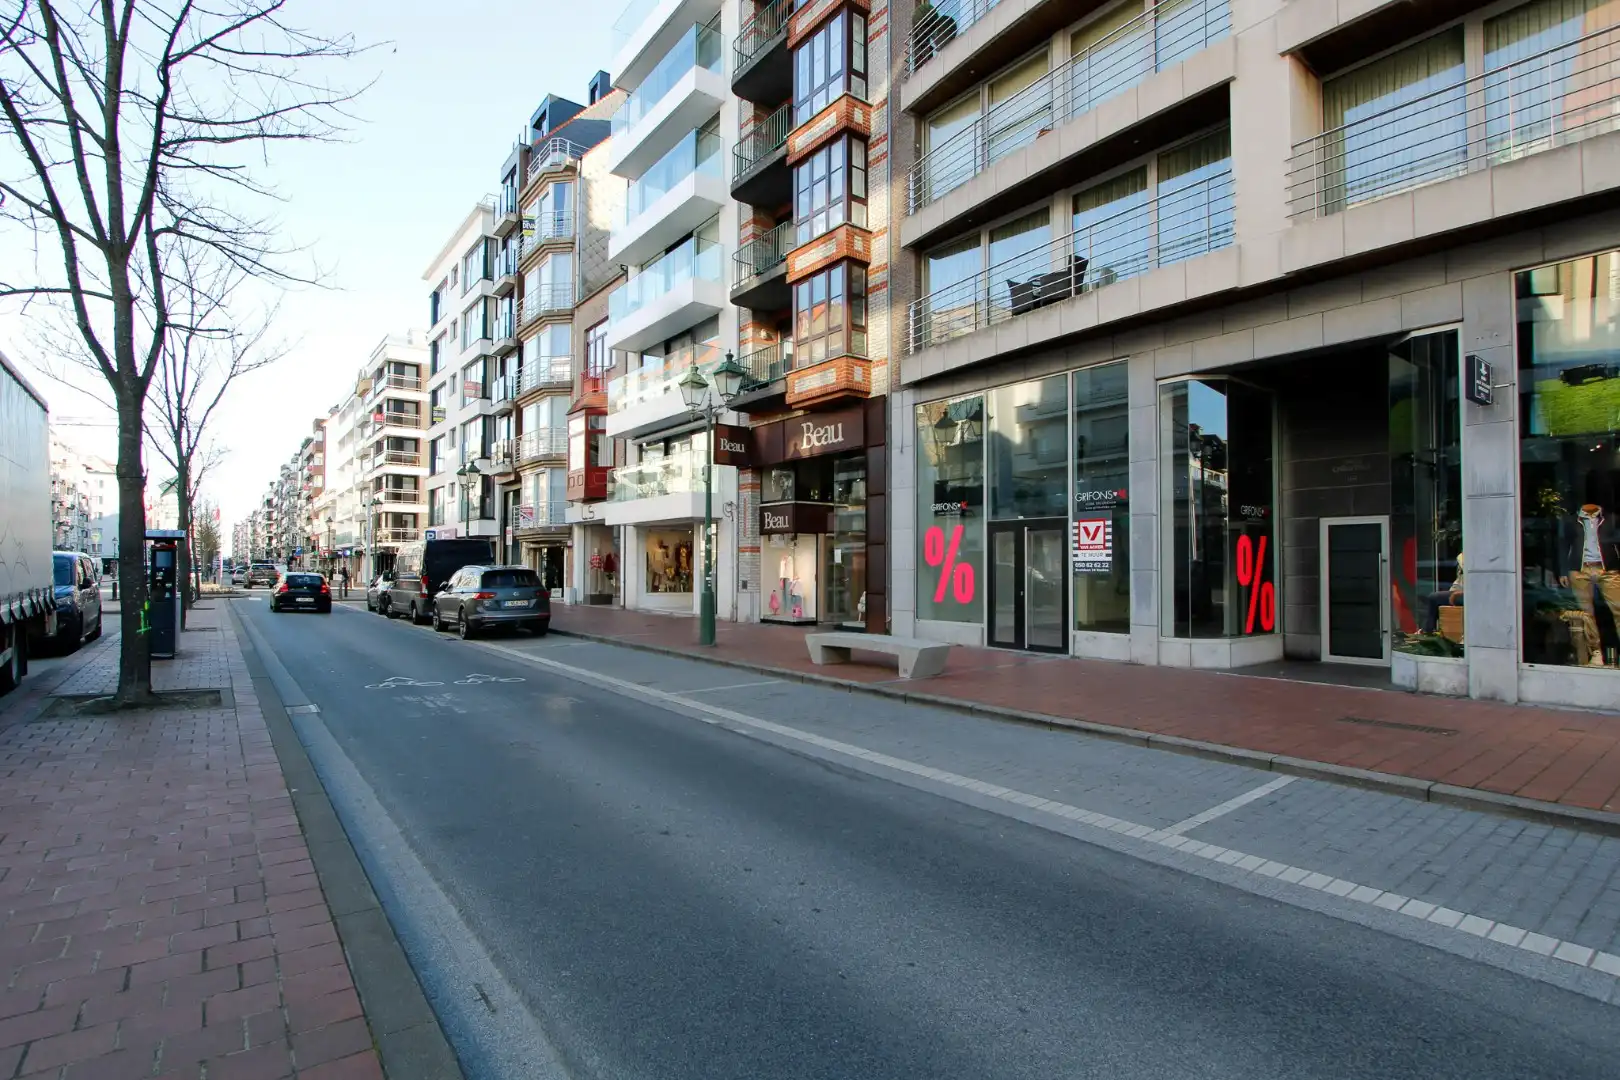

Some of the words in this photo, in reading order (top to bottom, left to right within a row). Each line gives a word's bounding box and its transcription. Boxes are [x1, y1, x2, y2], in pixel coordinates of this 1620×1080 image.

[800, 421, 844, 450] Beau
[720, 438, 746, 453] Beau
[1074, 490, 1113, 502] GRIFONS
[763, 512, 789, 530] Beau
